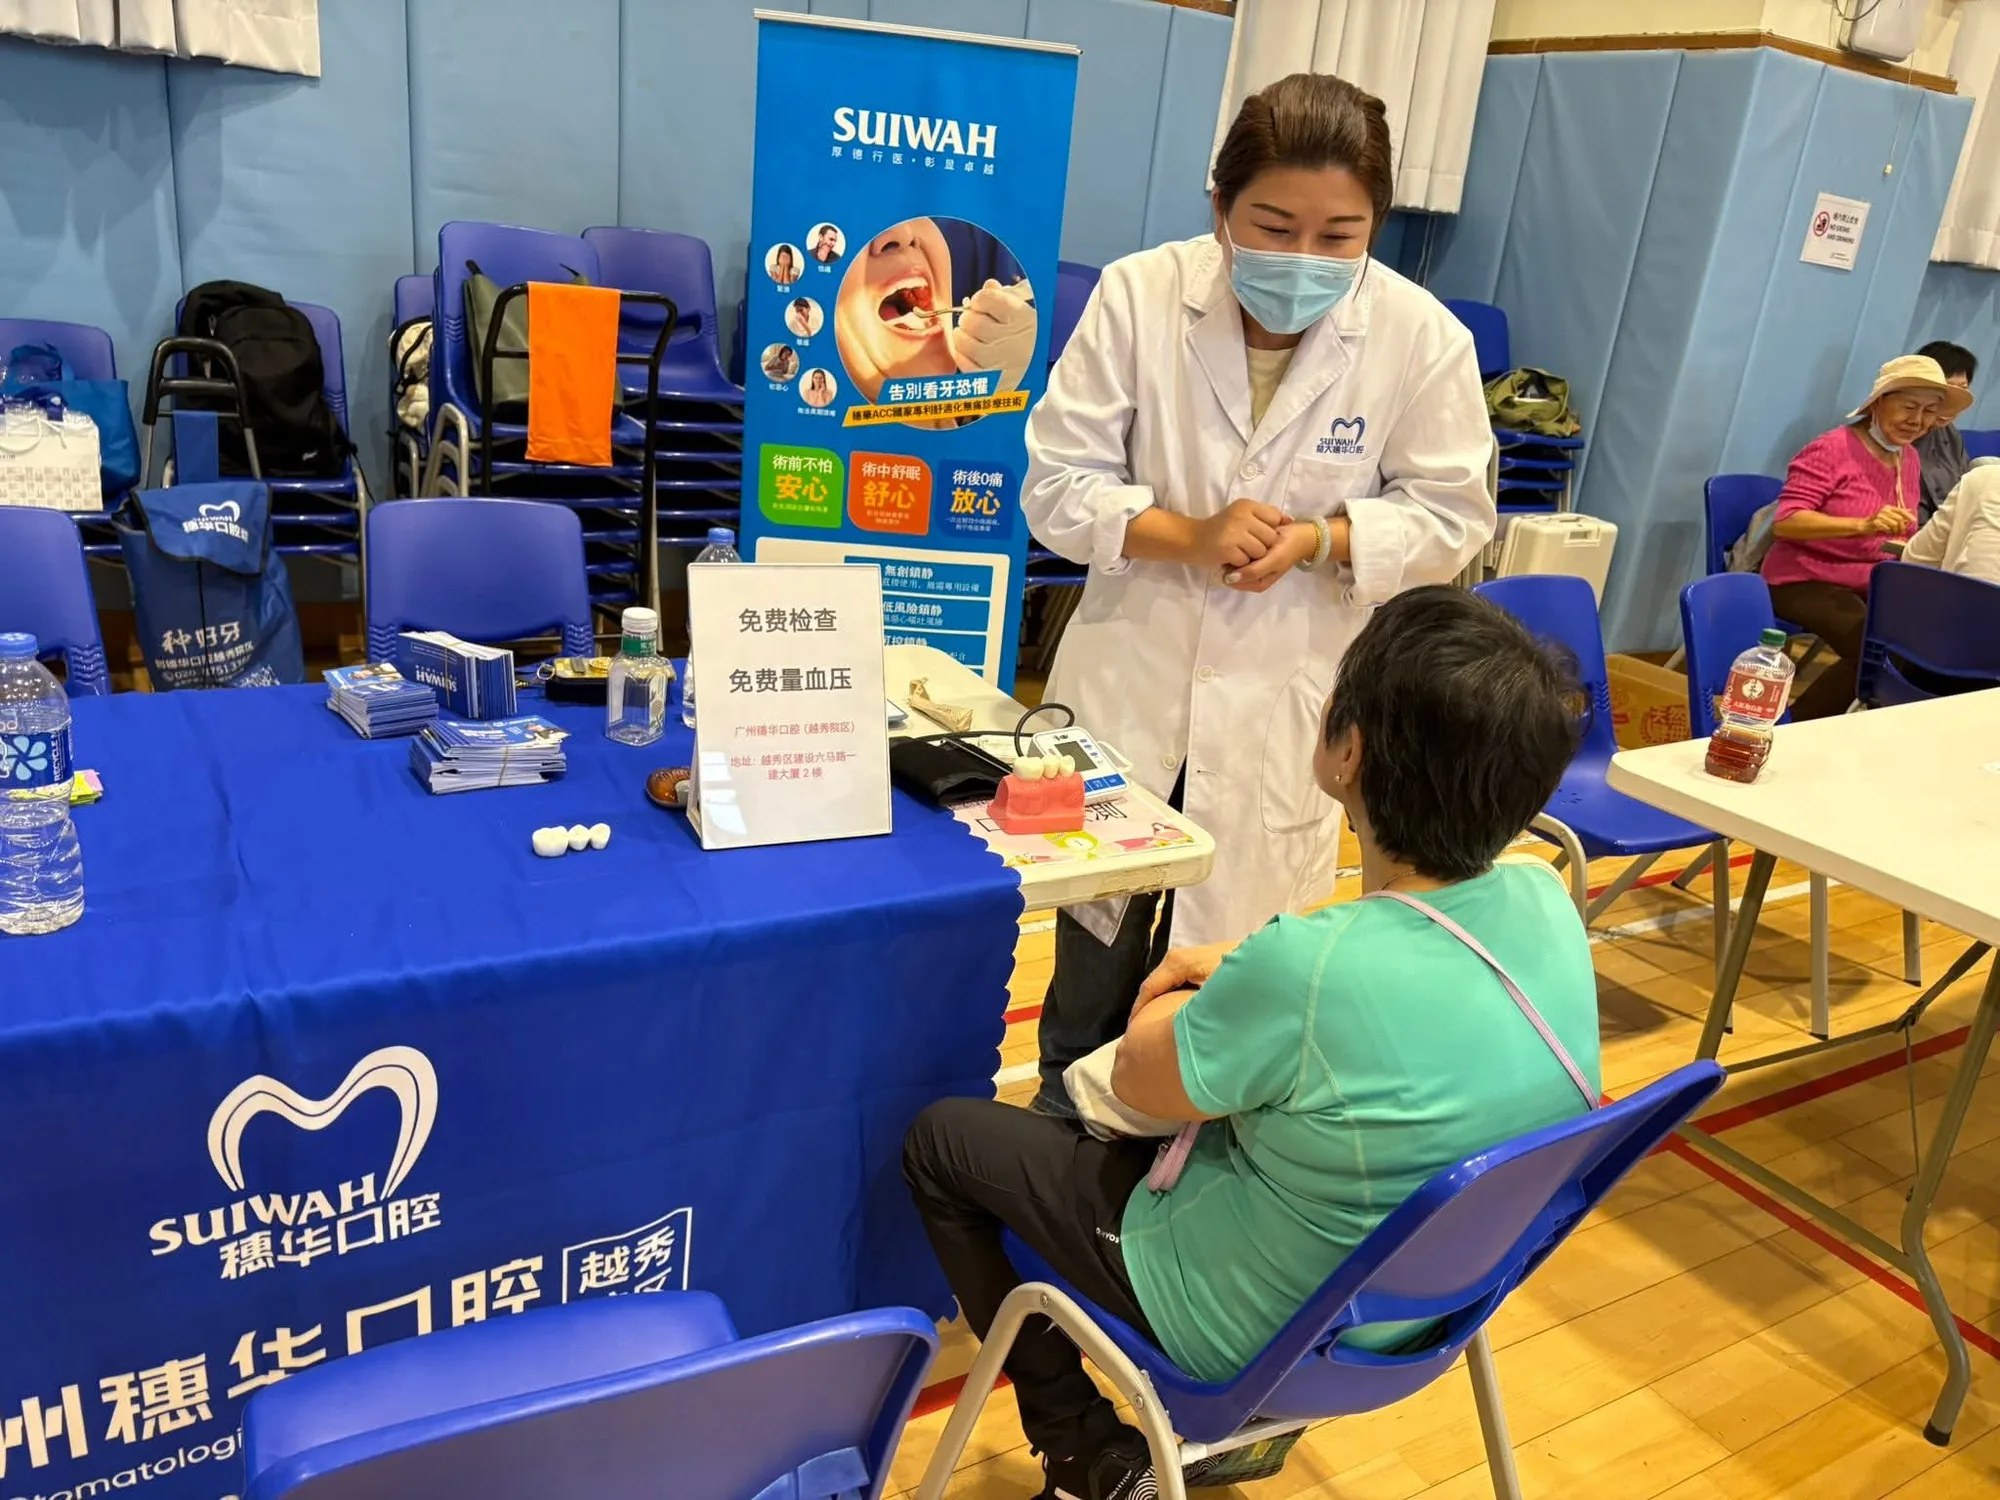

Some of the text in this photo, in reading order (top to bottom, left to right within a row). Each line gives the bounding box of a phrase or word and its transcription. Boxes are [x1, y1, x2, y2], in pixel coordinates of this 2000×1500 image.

[832, 106, 998, 158] SUIWAH
[888, 376, 989, 401] 告別看牙恐懼
[1319, 437, 1353, 446] SUIWAH
[772, 454, 833, 474] 術前不怕
[861, 461, 921, 481] 術中舒眠
[952, 469, 1004, 487] 術後0痛
[775, 474, 828, 503] 安心
[863, 480, 915, 509] 舒心
[950, 487, 1001, 515] 放心
[738, 608, 837, 634] 免费检查
[728, 667, 852, 694] 免费量血压
[50, 737, 61, 782] RECYCLE
[149, 1172, 376, 1257] SUIWAH
[220, 1192, 442, 1280] 穗华口腔
[579, 1225, 675, 1293] 越秀
